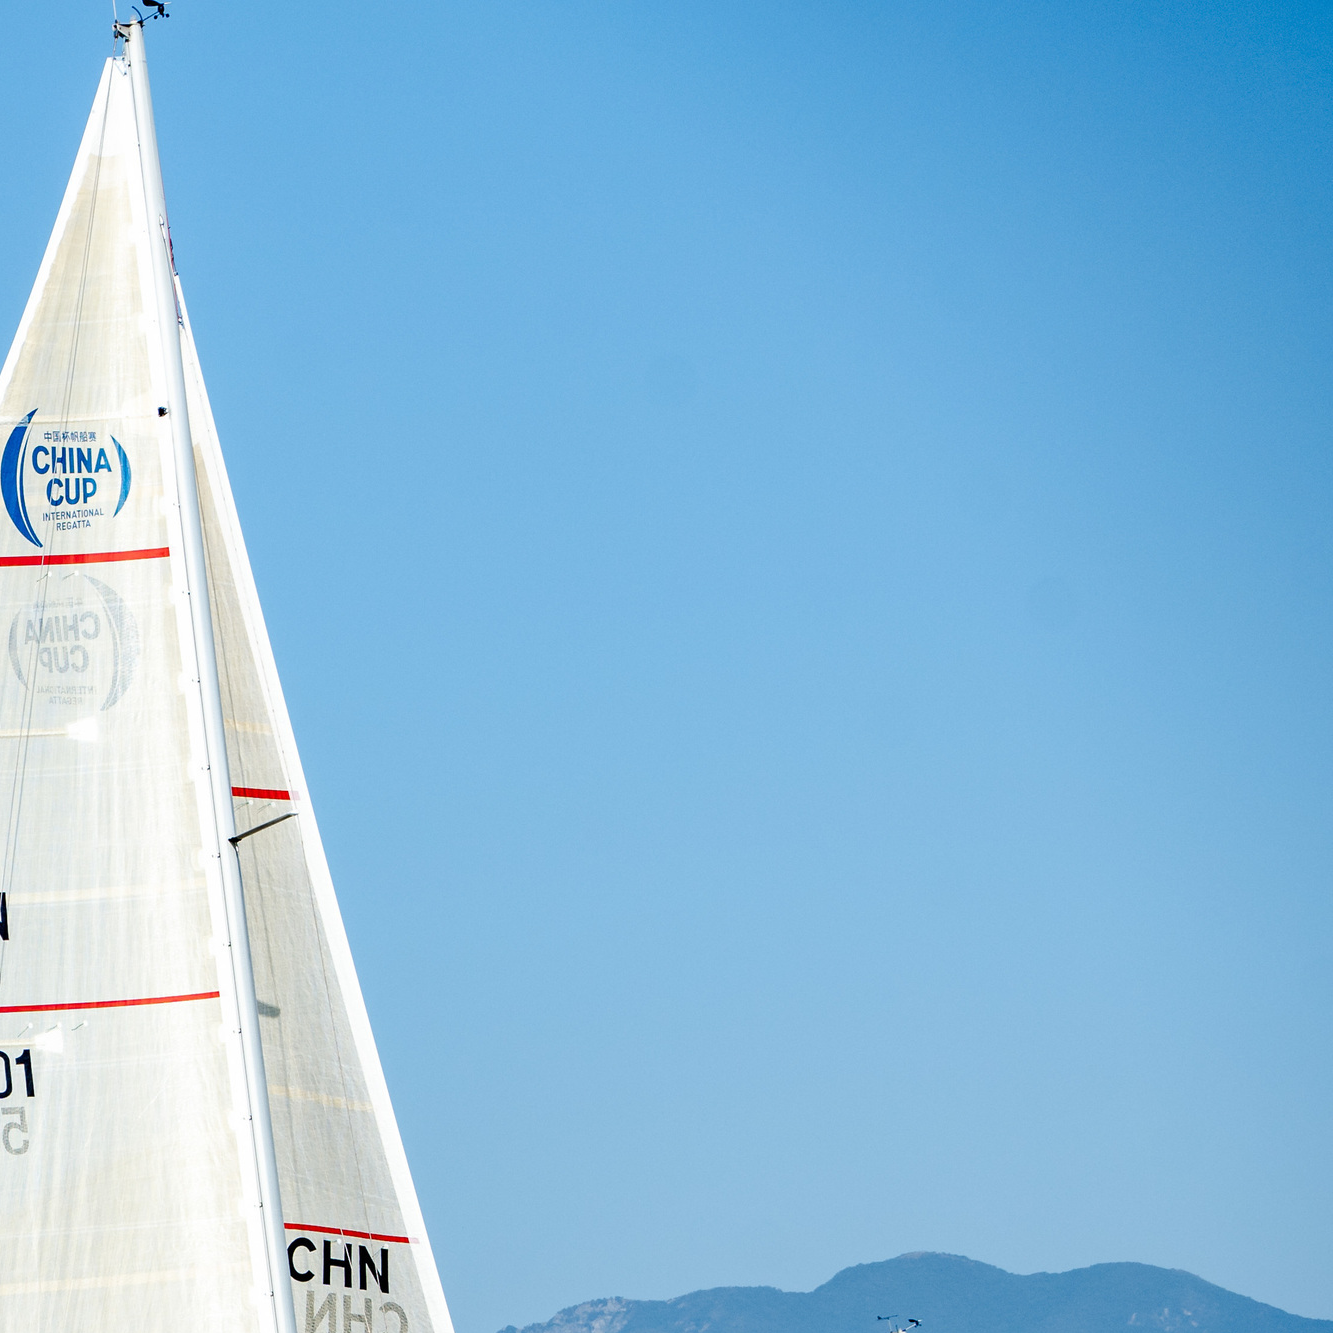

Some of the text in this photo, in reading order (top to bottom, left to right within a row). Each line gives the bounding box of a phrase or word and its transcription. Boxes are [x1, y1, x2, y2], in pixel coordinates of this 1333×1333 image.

[32, 445, 112, 475] CHINA
[46, 478, 97, 507] CUP
[42, 508, 104, 522] INTERNATIONAL
[56, 519, 91, 531] REGATTA
[287, 1236, 390, 1294] CHN
